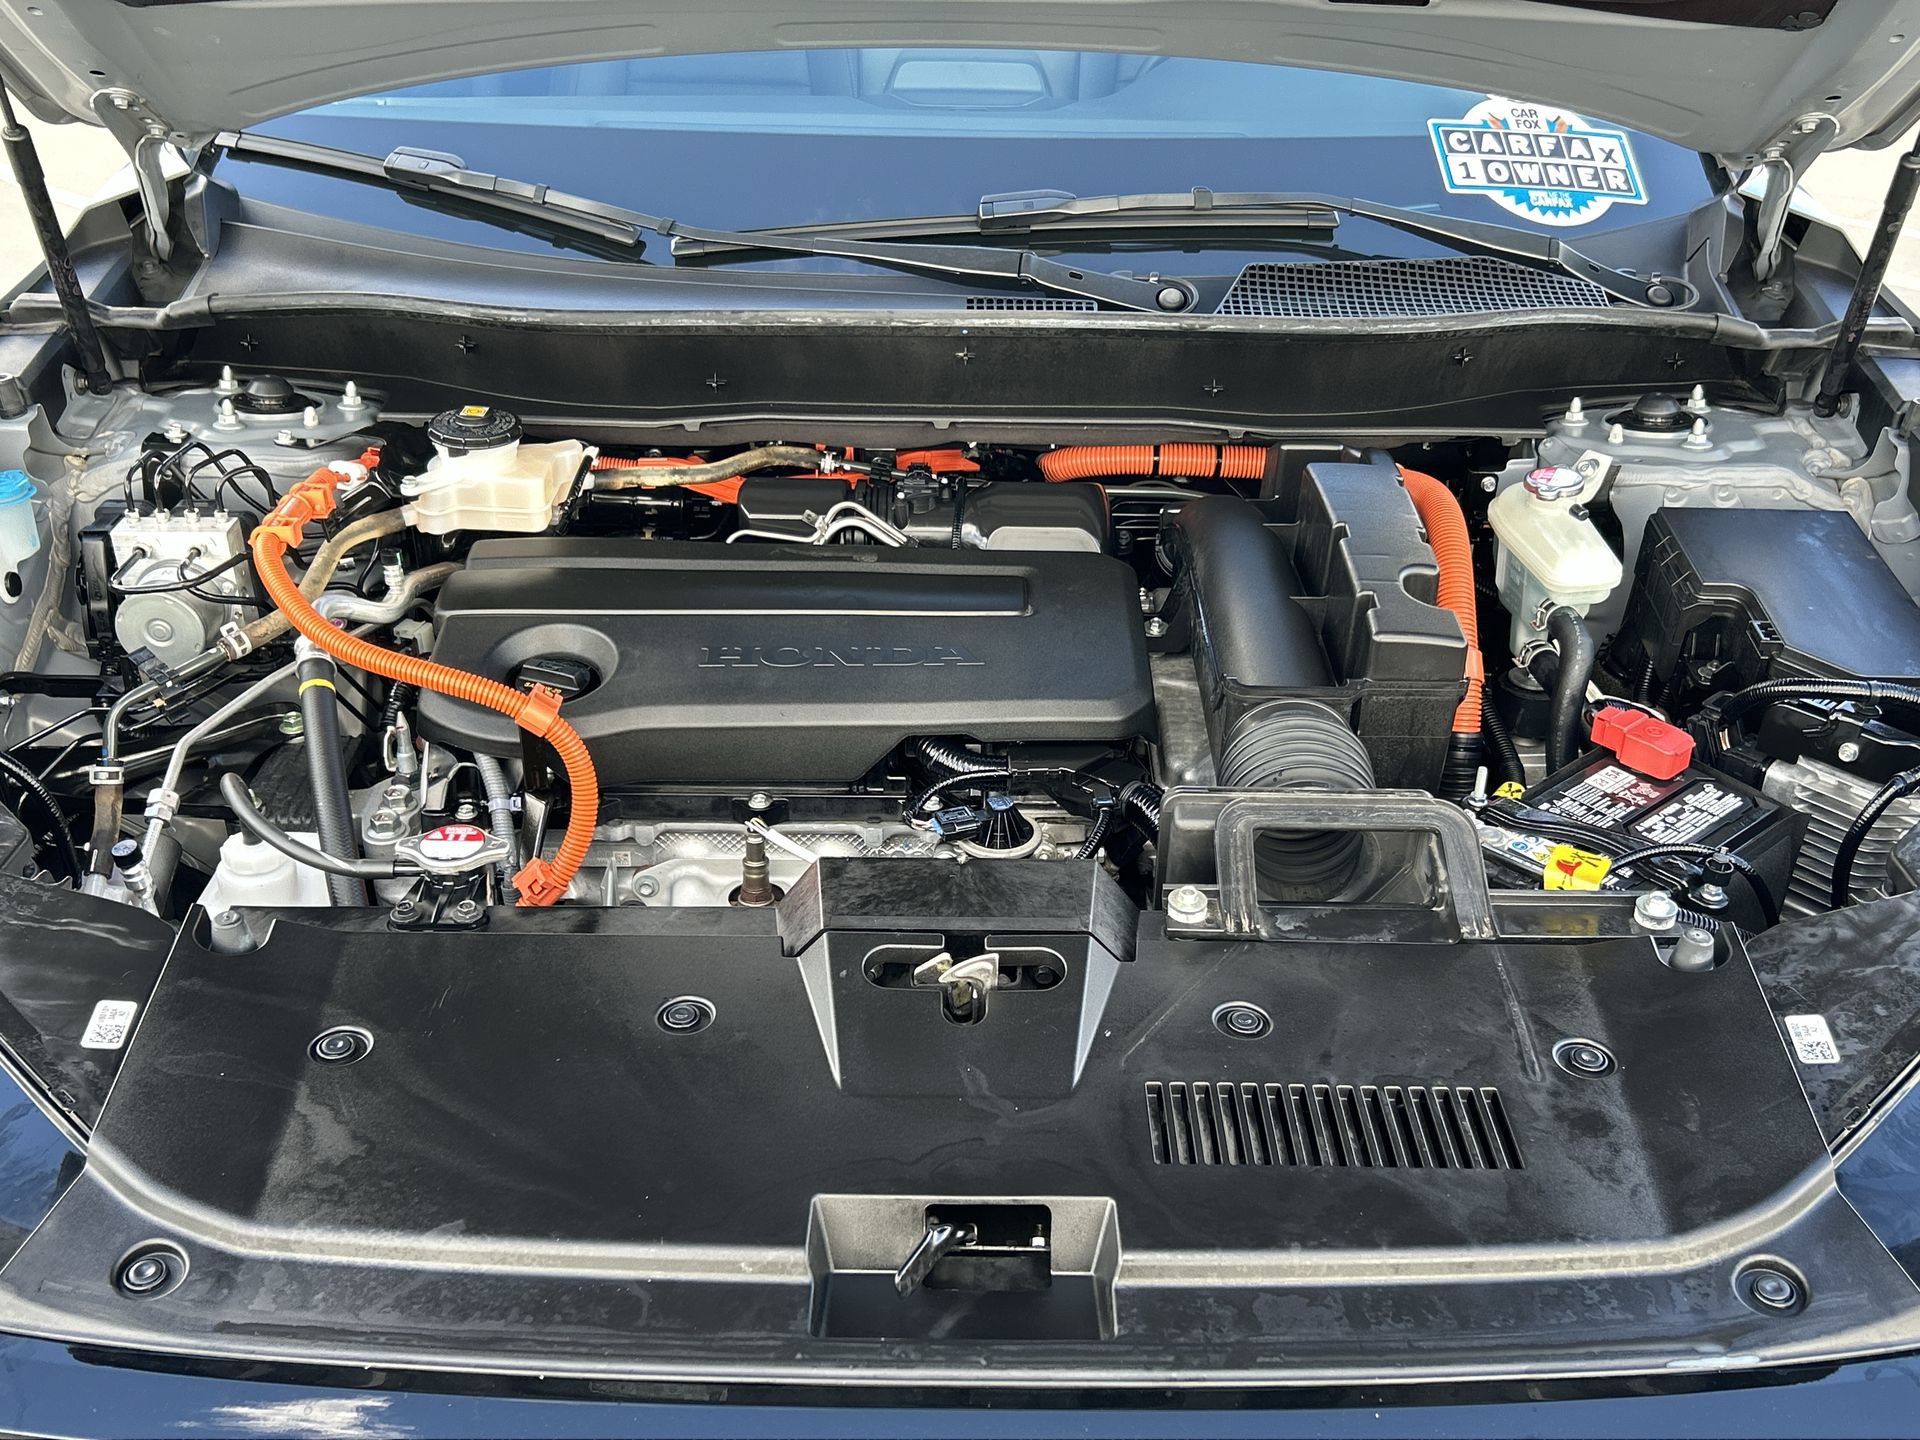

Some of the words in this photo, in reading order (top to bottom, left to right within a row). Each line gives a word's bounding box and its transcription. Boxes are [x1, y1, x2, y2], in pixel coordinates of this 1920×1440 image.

[1511, 108, 1539, 119] CAR
[1515, 119, 1542, 130] FOX
[1447, 130, 1620, 164] CARFAX
[1458, 161, 1477, 179] 1
[1486, 161, 1629, 191] OWNER
[698, 646, 985, 667] HONDA
